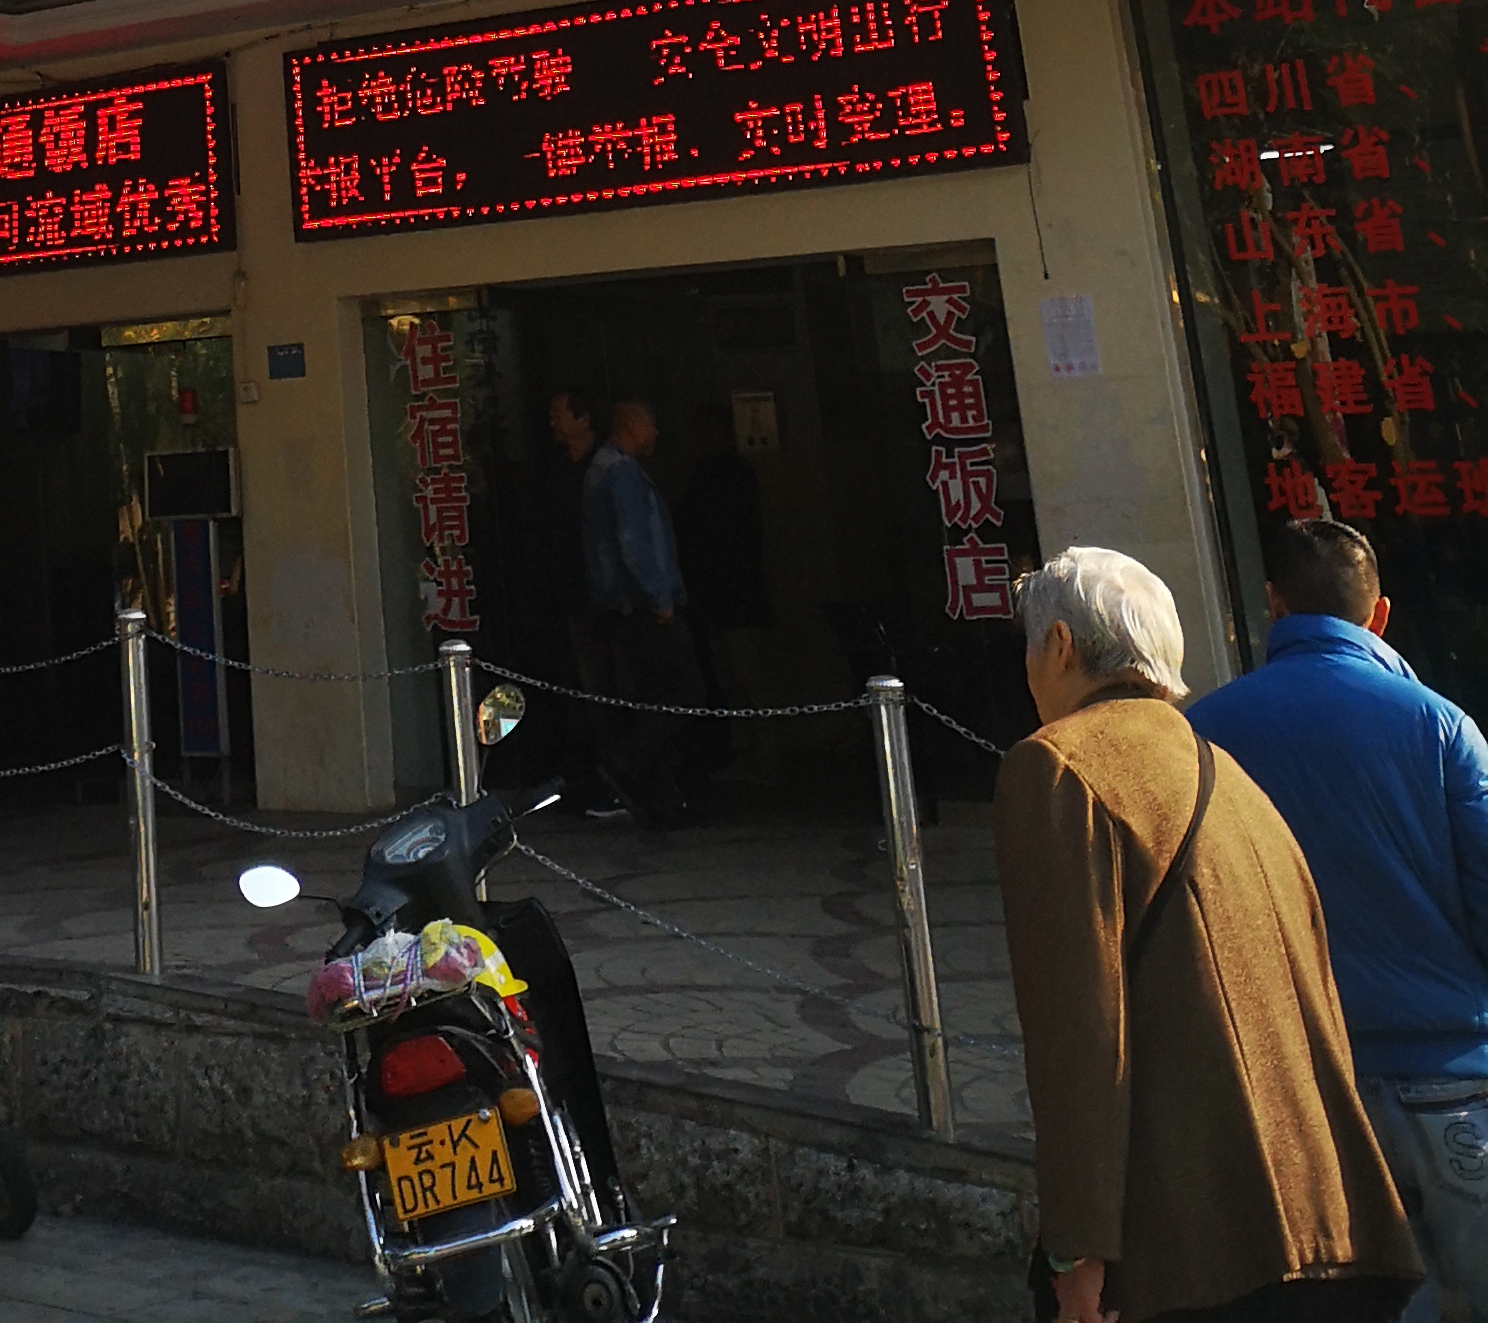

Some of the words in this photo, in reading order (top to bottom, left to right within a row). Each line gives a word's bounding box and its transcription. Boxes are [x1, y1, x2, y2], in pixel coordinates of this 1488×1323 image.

[402, 319, 481, 633] 住宿请进
[902, 272, 1013, 621] 交通饭店
[397, 1149, 505, 1215] DR744
